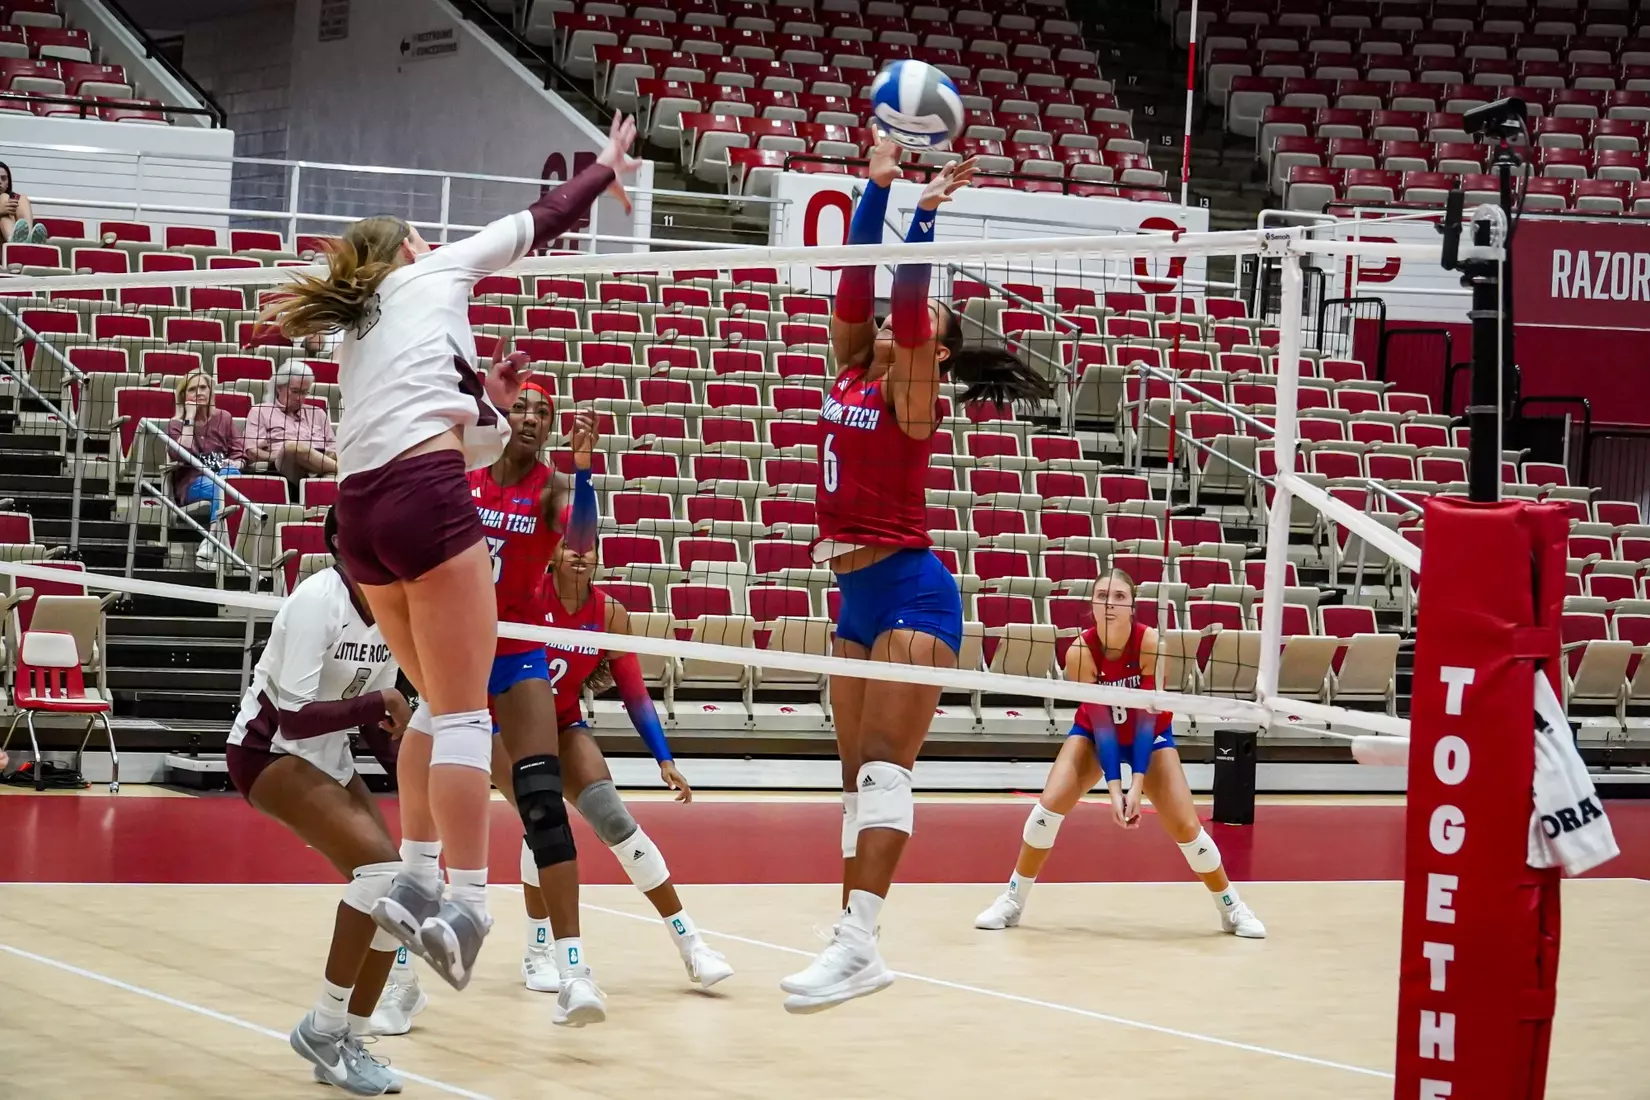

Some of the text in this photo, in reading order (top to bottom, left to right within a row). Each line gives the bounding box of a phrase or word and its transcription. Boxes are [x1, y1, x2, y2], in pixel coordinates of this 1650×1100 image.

[1128, 76, 1138, 85] 17
[1144, 106, 1155, 116] 16
[1161, 135, 1172, 145] 15
[1199, 198, 1210, 208] 13
[663, 215, 674, 227] 11
[1242, 261, 1251, 274] 11
[1551, 248, 1650, 302] RAZOR
[844, 404, 881, 431] TECH
[823, 432, 839, 494] 6
[505, 513, 538, 535] TECH
[333, 641, 368, 662] LITTLE
[548, 657, 568, 695] 2
